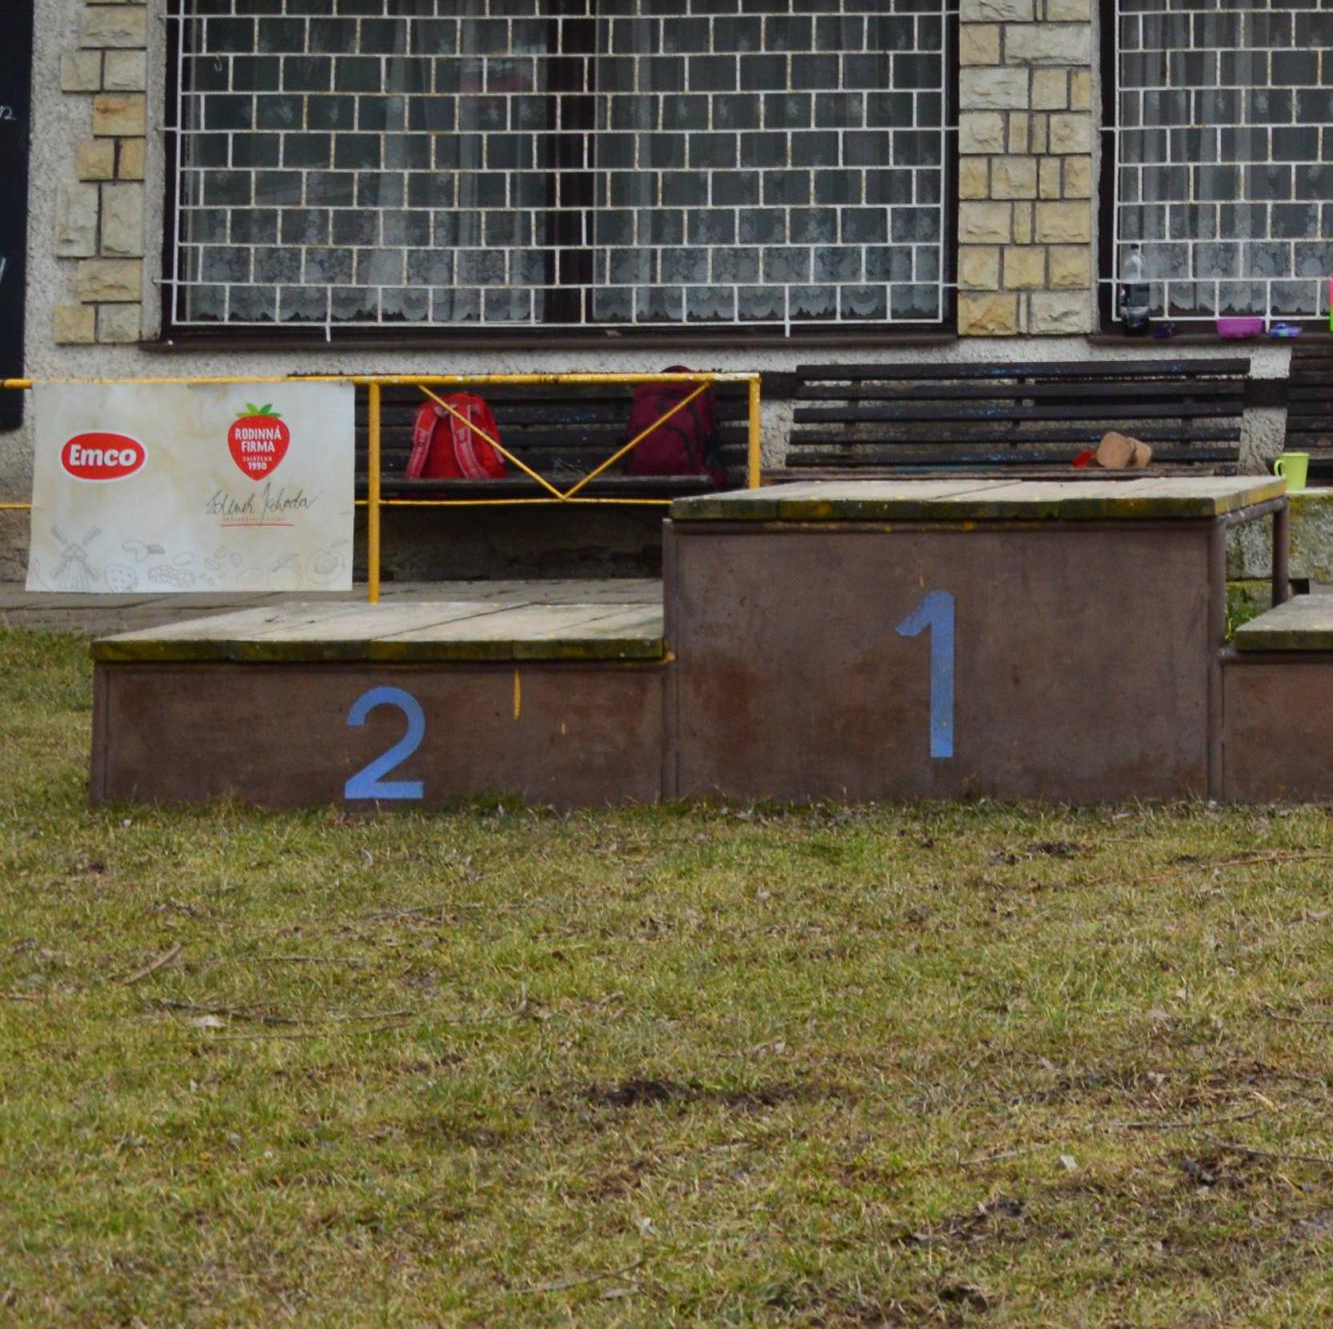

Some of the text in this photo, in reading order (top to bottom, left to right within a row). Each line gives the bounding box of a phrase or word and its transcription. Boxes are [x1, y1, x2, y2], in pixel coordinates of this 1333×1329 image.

[235, 425, 282, 441] RODINNÁ
[69, 443, 137, 467] Emco
[241, 440, 276, 453] FIRMA
[895, 588, 955, 759] 1
[344, 685, 425, 800] 2
